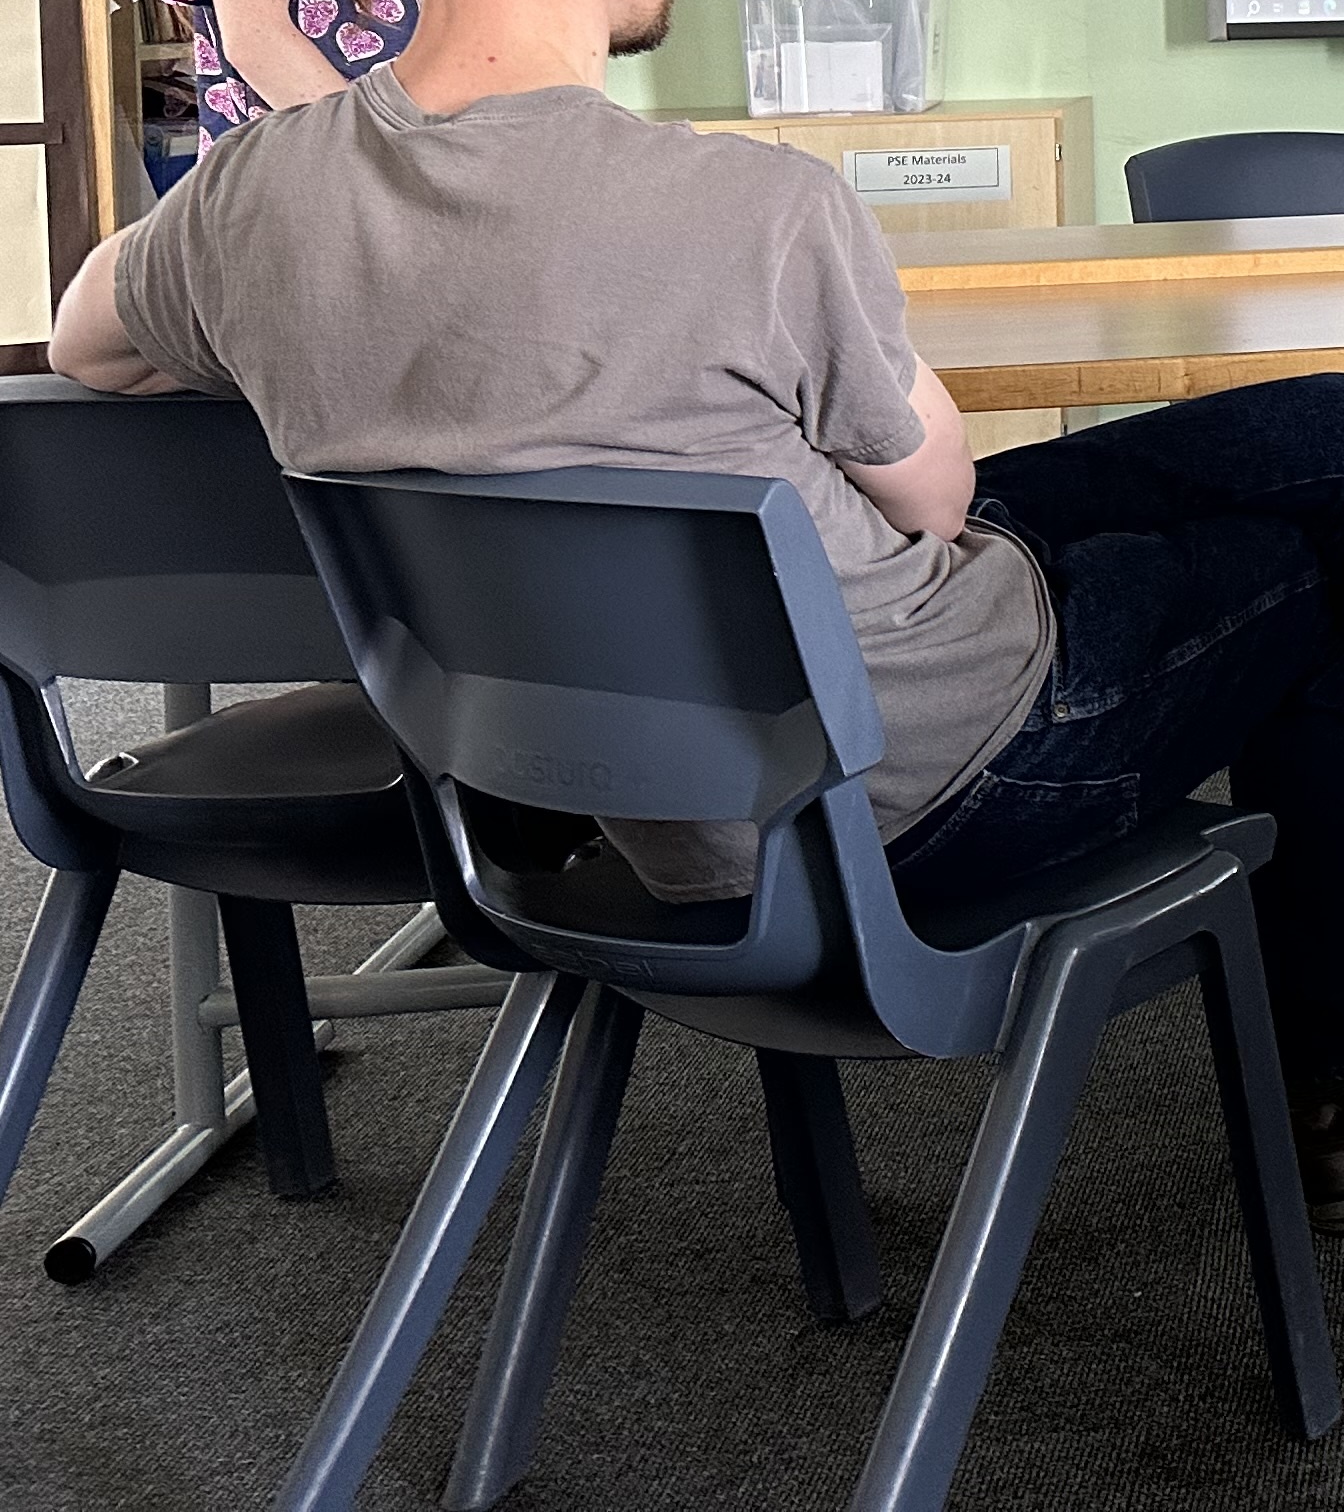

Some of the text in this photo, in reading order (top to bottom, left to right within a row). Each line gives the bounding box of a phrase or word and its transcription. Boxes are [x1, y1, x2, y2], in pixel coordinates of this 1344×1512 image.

[887, 153, 967, 166] PSE Materials
[903, 174, 951, 186] 2023-24
